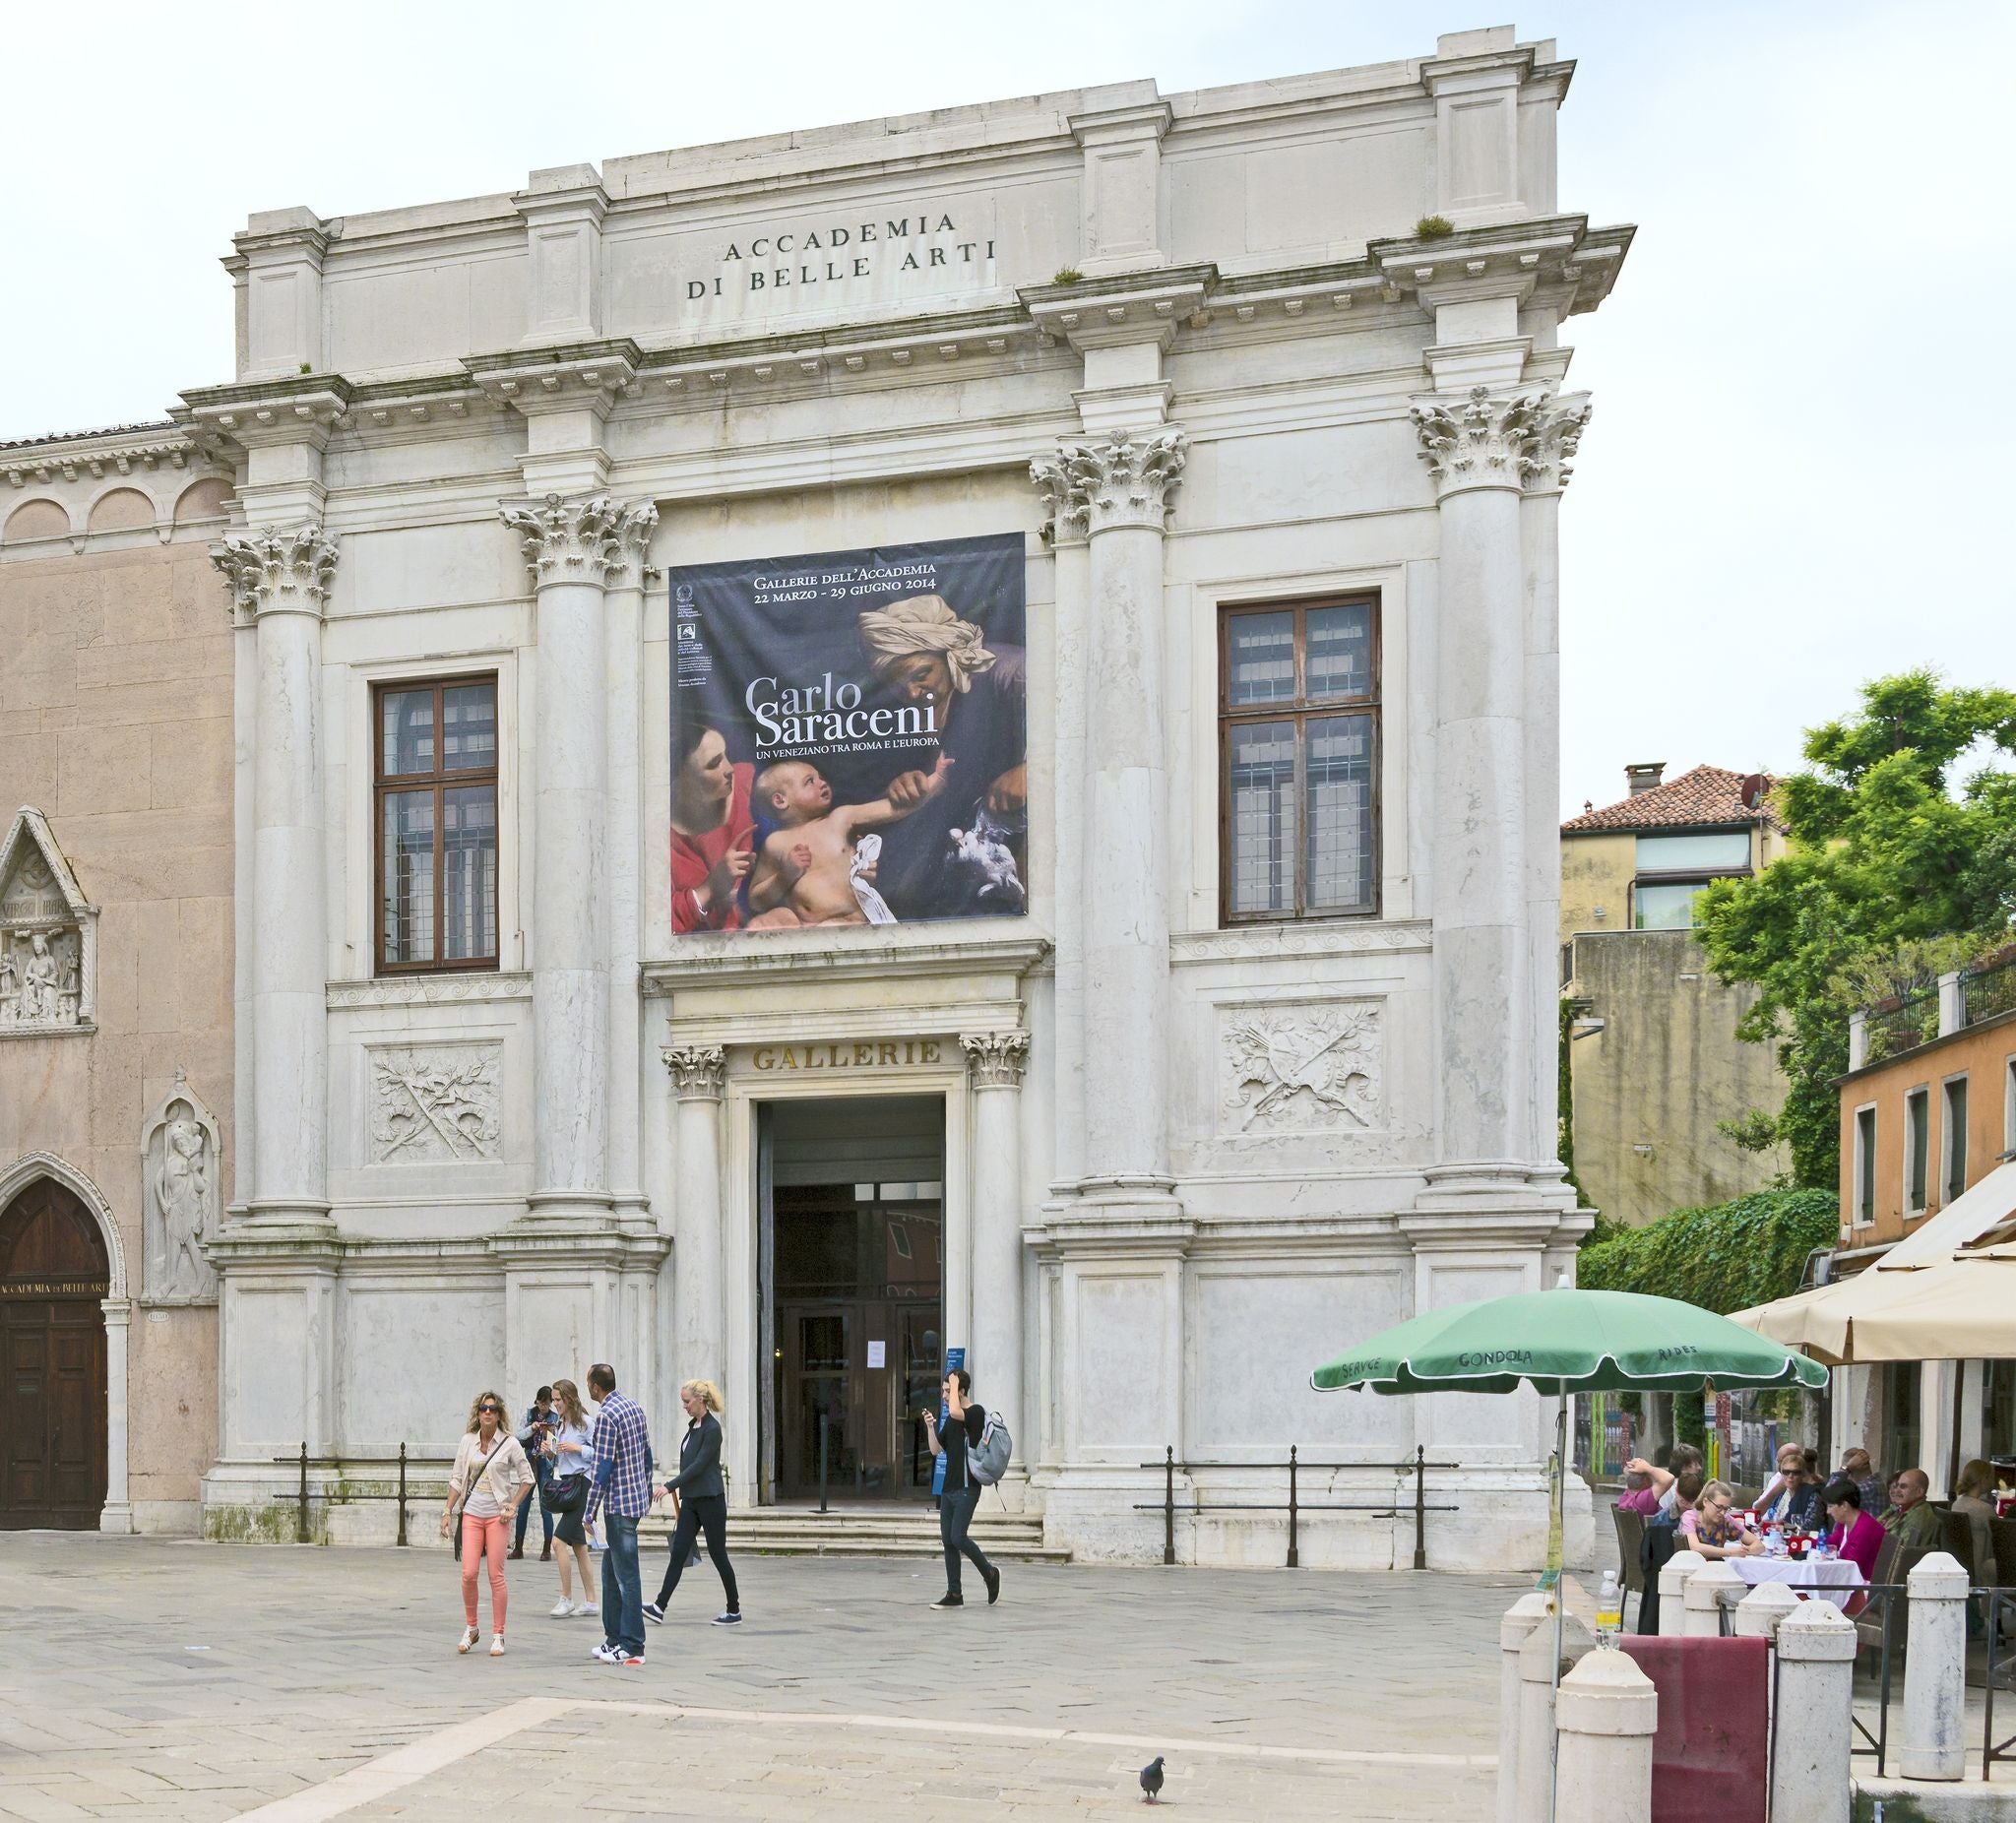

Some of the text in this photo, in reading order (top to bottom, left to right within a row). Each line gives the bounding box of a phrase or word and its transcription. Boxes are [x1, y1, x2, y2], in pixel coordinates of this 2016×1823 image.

[724, 214, 956, 261] ACCADEMIA
[687, 240, 995, 299] DI BELLE ARTI
[753, 576, 818, 591] GALLERIE
[754, 594, 769, 604] 22
[772, 590, 818, 603] MARZO
[830, 588, 847, 599] 29
[850, 581, 902, 597] GIUGNO
[905, 577, 937, 590] 2014
[745, 671, 862, 718] Carlo
[755, 692, 939, 748] Saraceni
[756, 737, 940, 760] UN VENEZIANO TRA ROMA E L'EUROPA
[752, 1040, 941, 1071] GALLERIE
[1458, 1350, 1534, 1367] GONDOLA
[1658, 1345, 1698, 1361] RIDES
